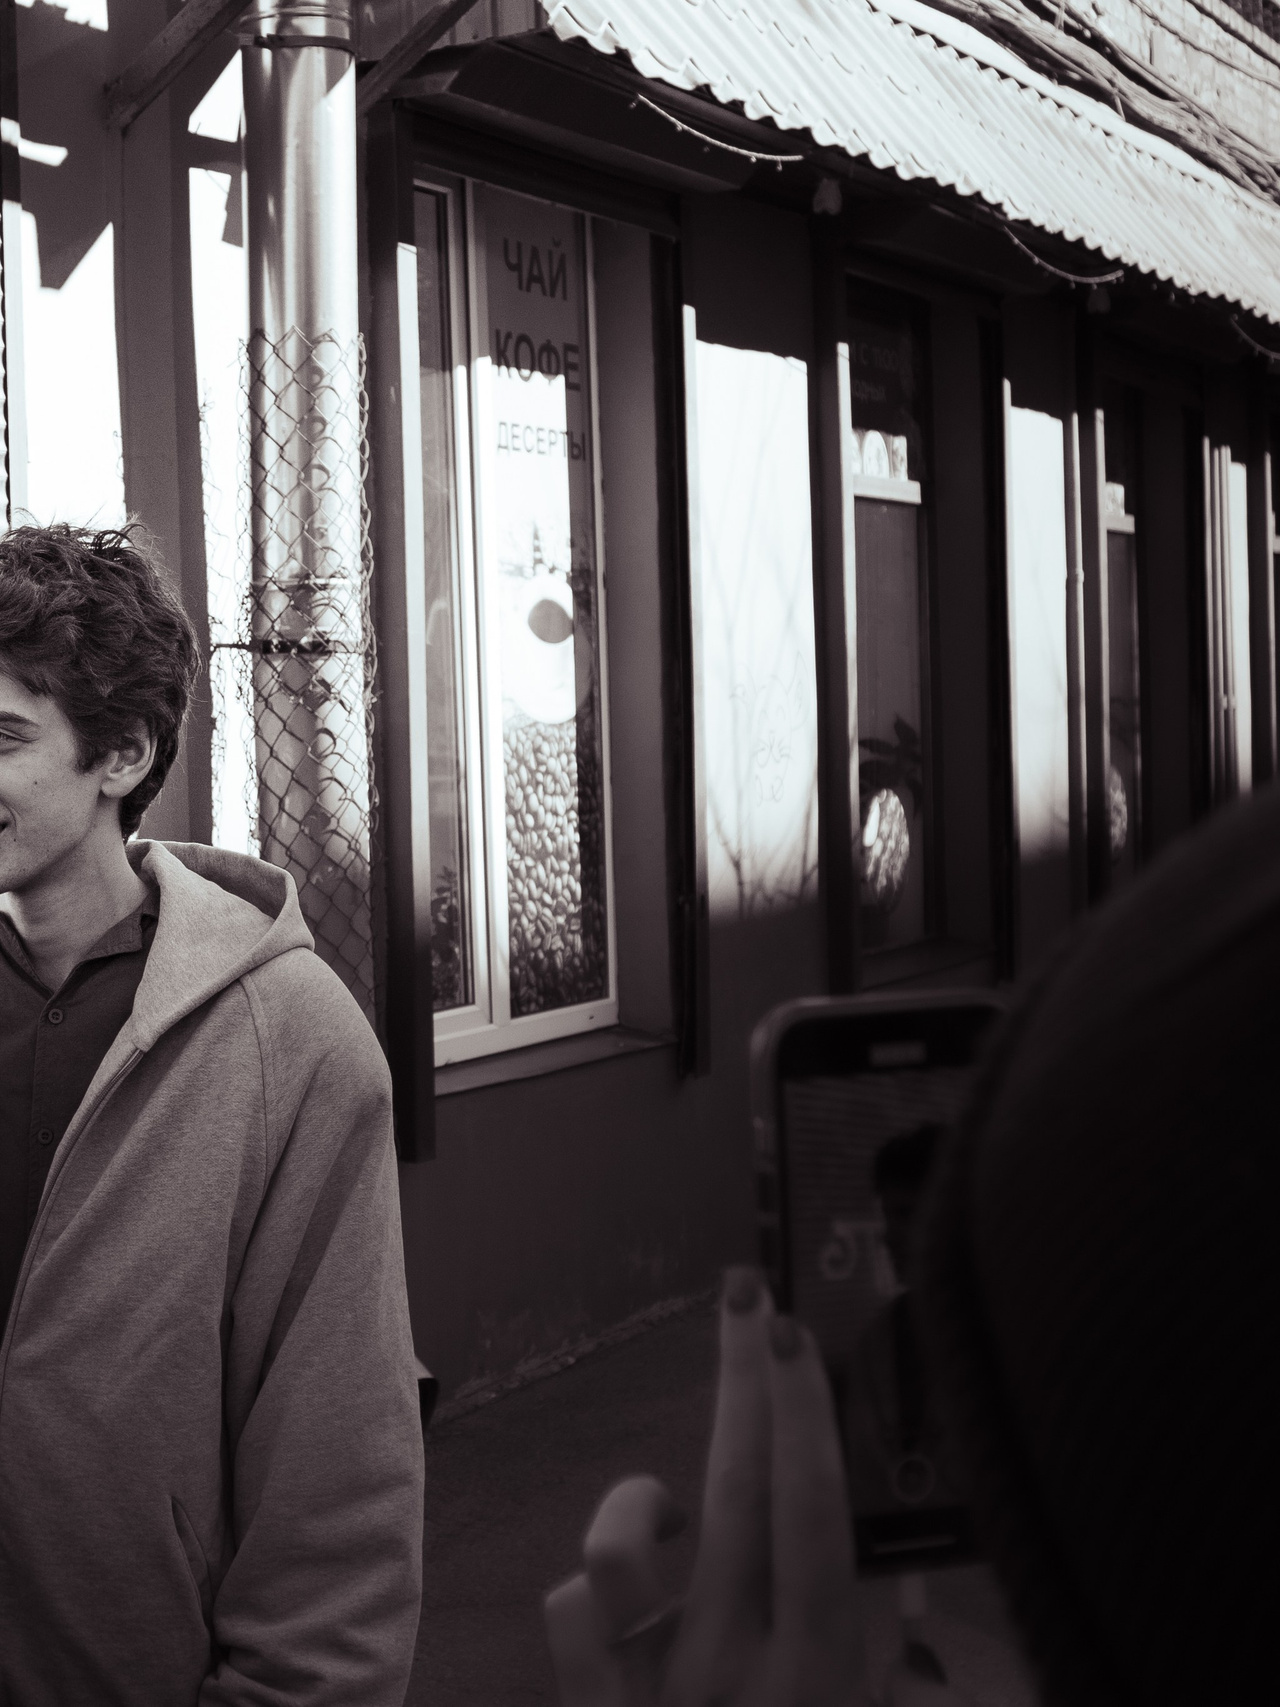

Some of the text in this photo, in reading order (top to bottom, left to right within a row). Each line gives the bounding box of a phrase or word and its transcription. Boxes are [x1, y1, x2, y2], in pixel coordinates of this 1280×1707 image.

[503, 236, 568, 300] ЧАЙ
[495, 327, 581, 391] КОФЕ
[496, 420, 587, 461] ДЕСЕРТЫ
